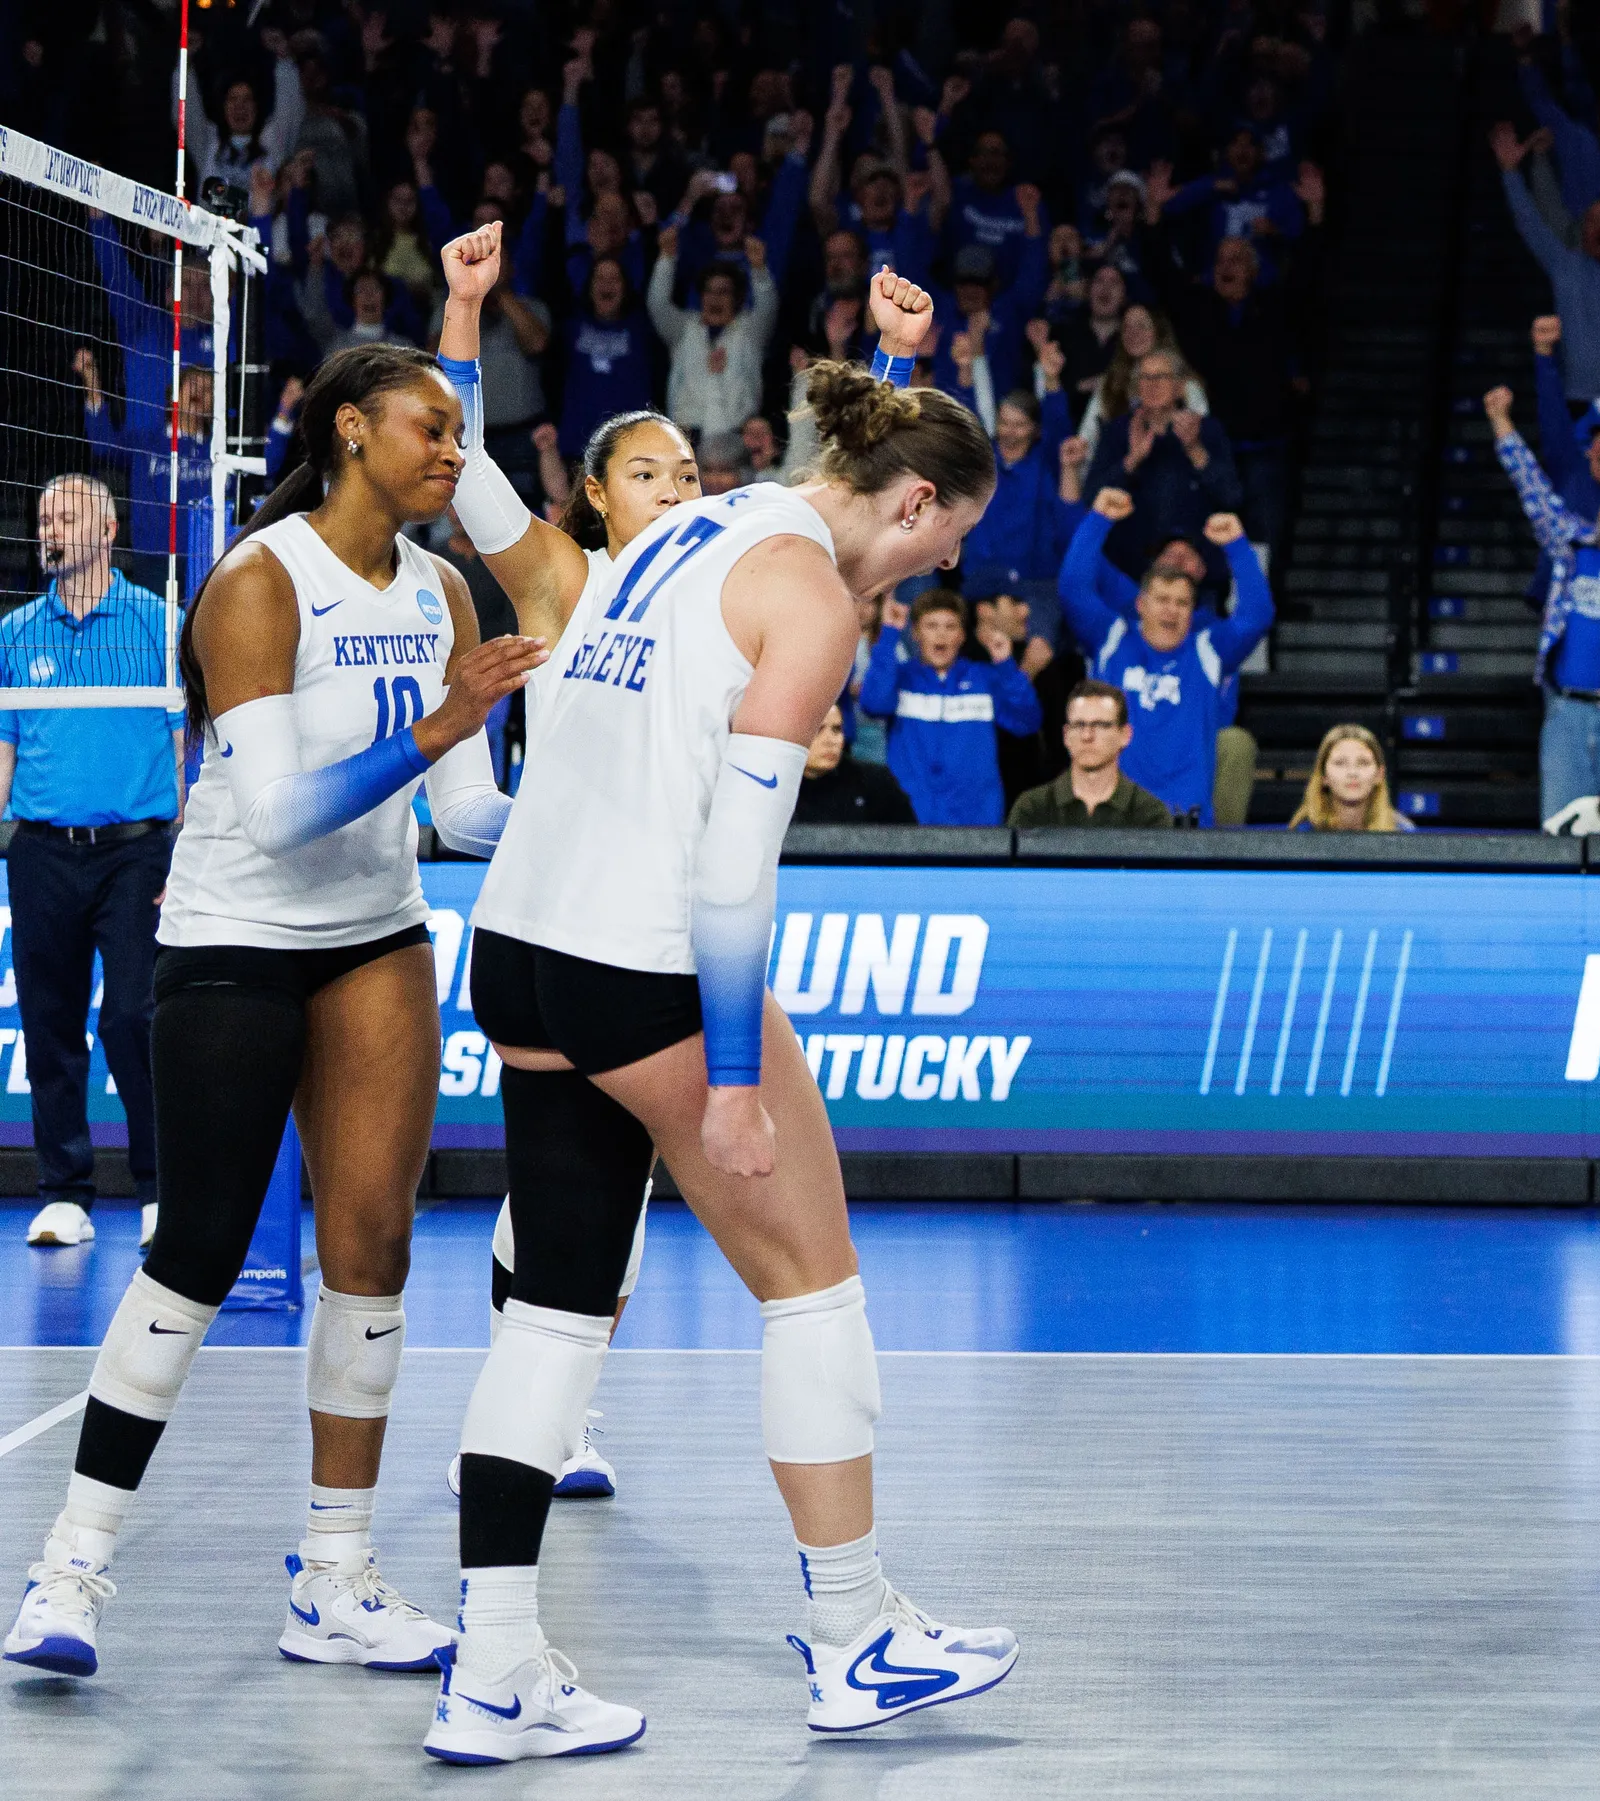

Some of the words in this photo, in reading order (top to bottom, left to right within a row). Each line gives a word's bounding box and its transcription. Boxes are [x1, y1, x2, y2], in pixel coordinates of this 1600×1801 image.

[604, 516, 727, 623] 17
[333, 634, 439, 667] KENTUCKY
[373, 676, 424, 746] 10
[766, 912, 990, 1016] UND
[795, 1034, 1033, 1101] NTUCKY
[243, 1268, 287, 1281] imports
[68, 1557, 93, 1570] NIKE
